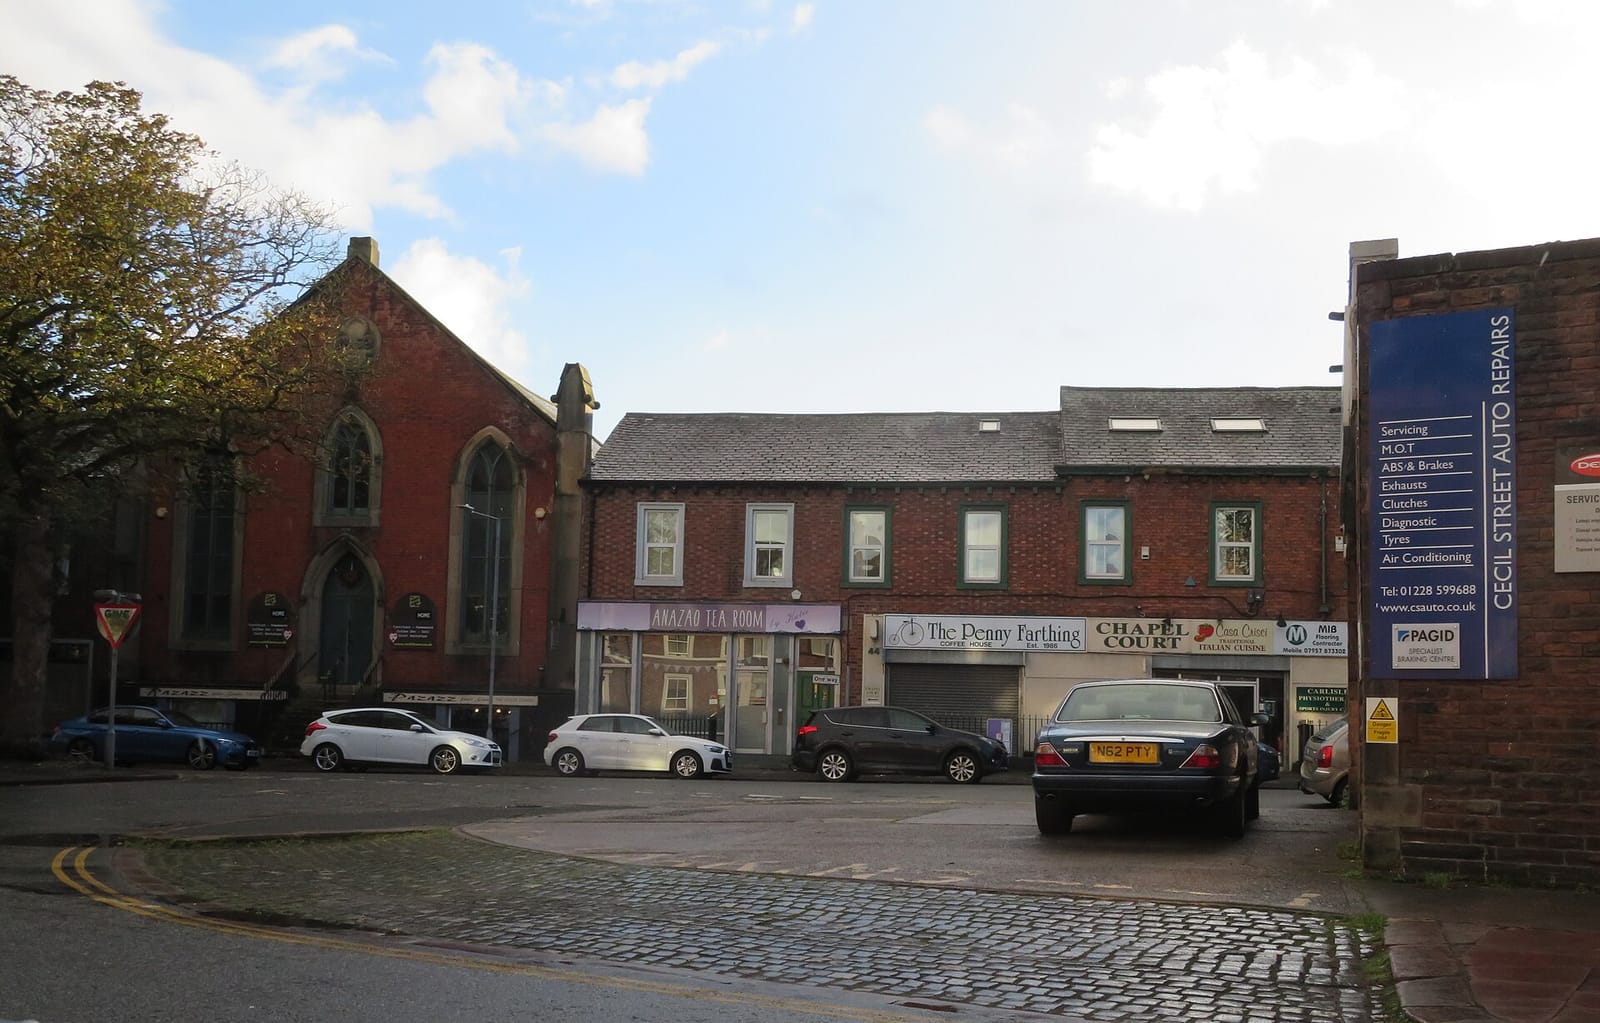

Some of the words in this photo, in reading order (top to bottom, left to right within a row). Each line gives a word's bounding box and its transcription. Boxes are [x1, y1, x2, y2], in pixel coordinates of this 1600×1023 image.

[1490, 315, 1510, 395] REPAIRS
[1381, 425, 1429, 437] Servicing
[1491, 401, 1511, 463] AUTO
[1381, 443, 1415, 454] M.O.T
[1381, 462, 1404, 473] ABS
[1406, 461, 1415, 471] &
[1419, 460, 1454, 471] Brakes
[1381, 480, 1428, 491] Exhausts
[1382, 498, 1429, 509] Clutches
[1492, 468, 1512, 543] STREET
[1382, 516, 1437, 530] Diagnostic
[1382, 534, 1410, 547] Tyres
[1382, 553, 1399, 564] Air
[1402, 551, 1472, 564] Conditioning
[1493, 548, 1512, 610] CECIL
[1380, 586, 1398, 597] Tel:
[1400, 586, 1433, 596] 01228
[1436, 585, 1476, 596] 599688
[1380, 601, 1476, 612] www.csauto.co.uk
[652, 609, 701, 628] ANAZAO
[706, 609, 727, 628] TEA
[733, 609, 763, 629] ROOM
[928, 622, 957, 640] The
[962, 623, 1012, 647] Penny
[1017, 624, 1081, 649] Farthing
[1096, 622, 1190, 636] CHAPEL
[1216, 623, 1238, 638] Casa
[1104, 635, 1181, 649] COURT
[1411, 630, 1454, 642] PAGID
[1233, 644, 1266, 652] CUISINE
[1097, 745, 1122, 757] N62
[1126, 746, 1151, 757] PTY
